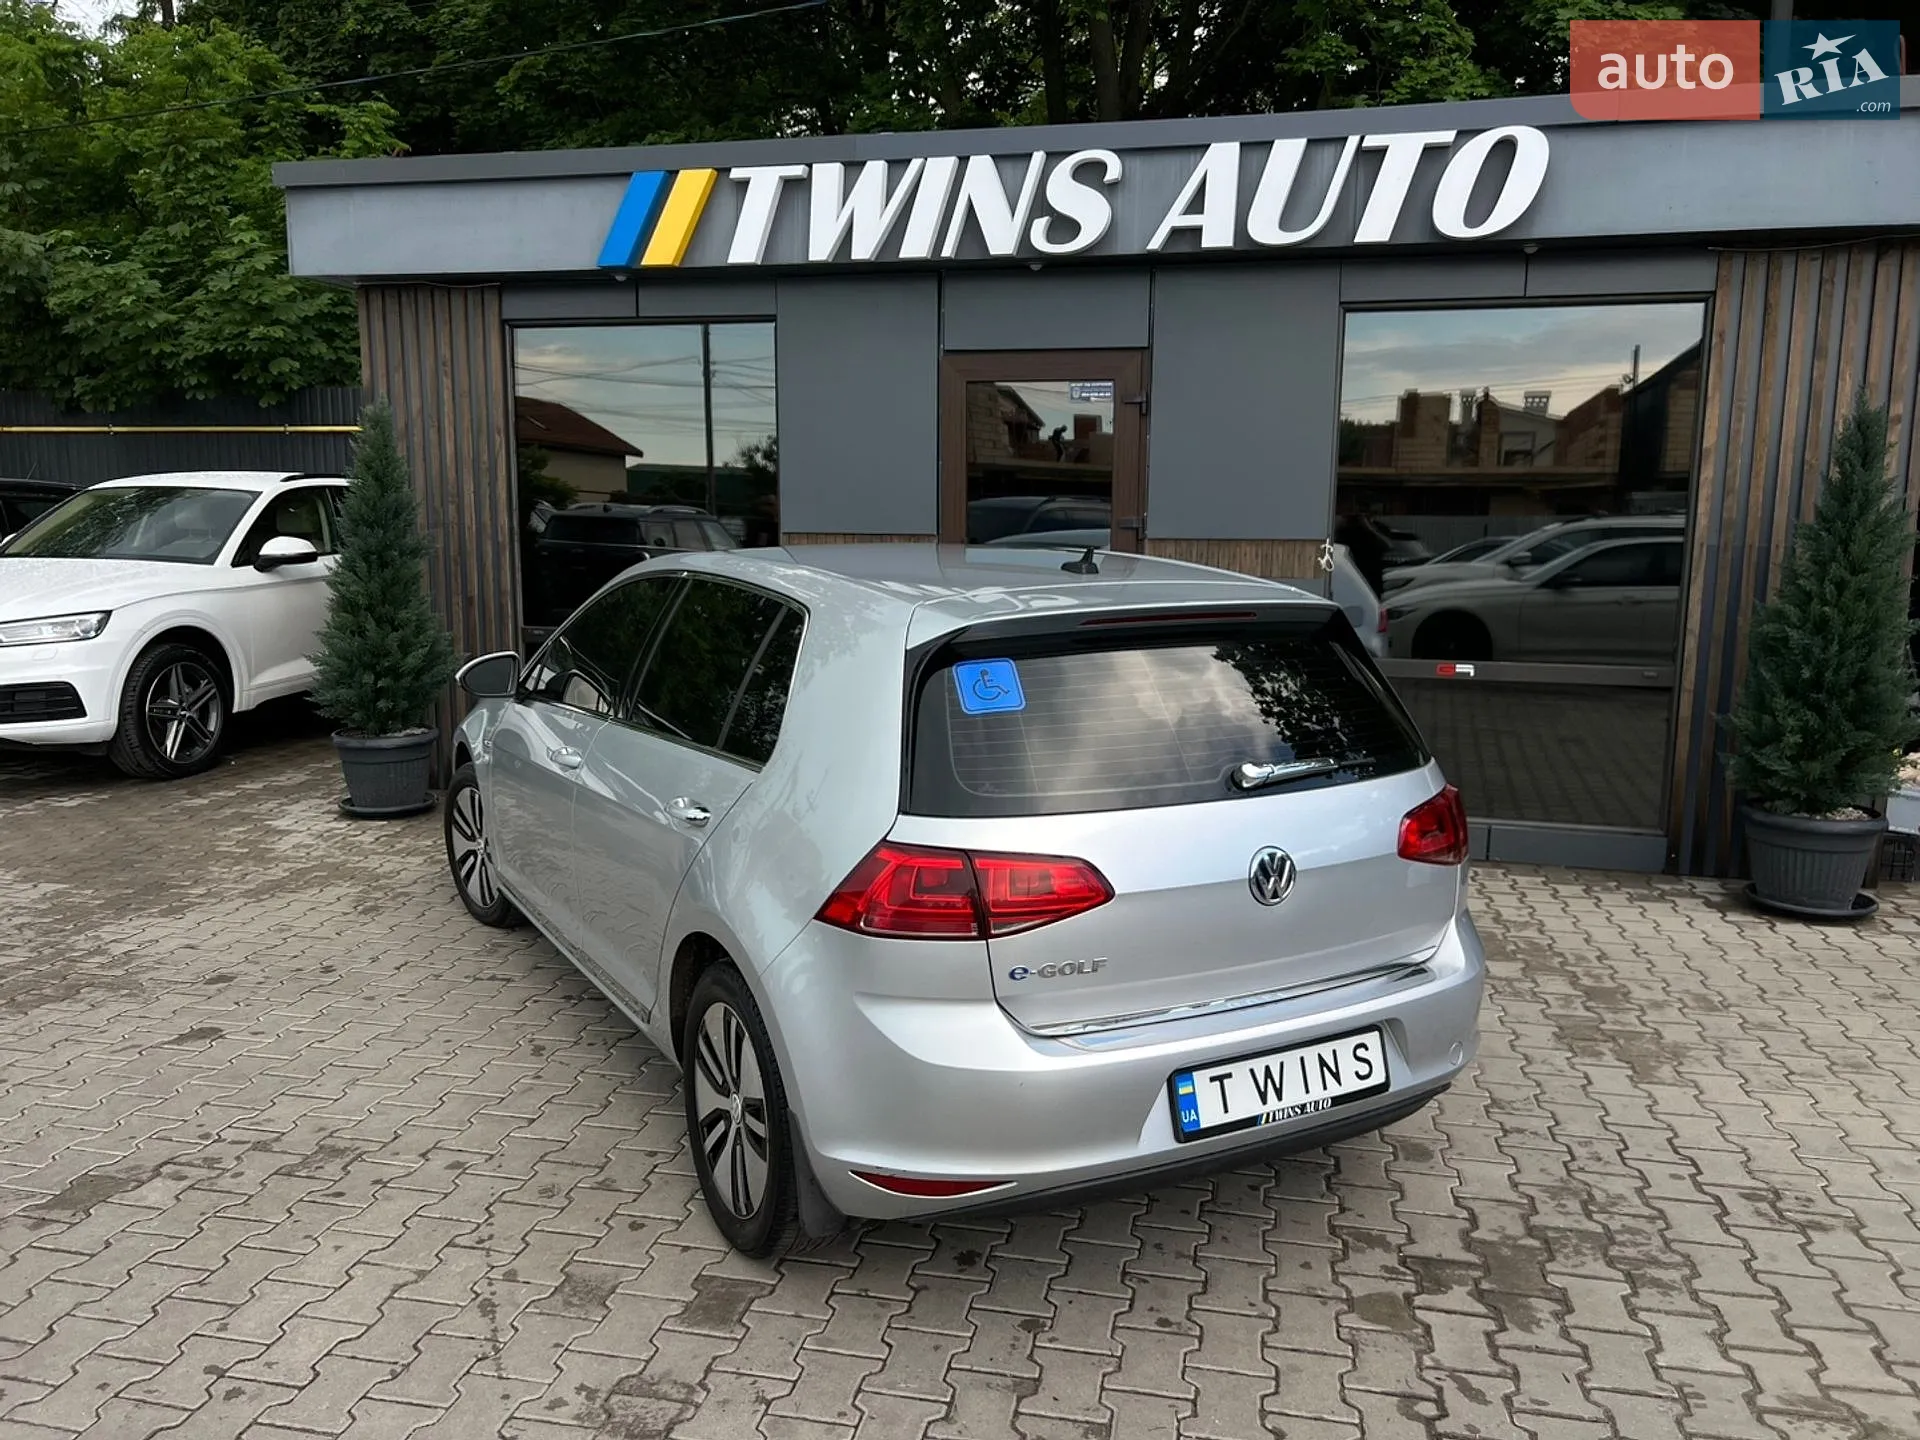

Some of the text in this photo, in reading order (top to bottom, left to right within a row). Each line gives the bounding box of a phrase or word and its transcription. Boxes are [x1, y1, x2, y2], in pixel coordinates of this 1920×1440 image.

[726, 125, 1551, 266] TWINS AUTO
[1008, 957, 1108, 981] e-GOLF
[1181, 1109, 1199, 1124] UA
[1268, 1097, 1332, 1123] TWINS AUTO
